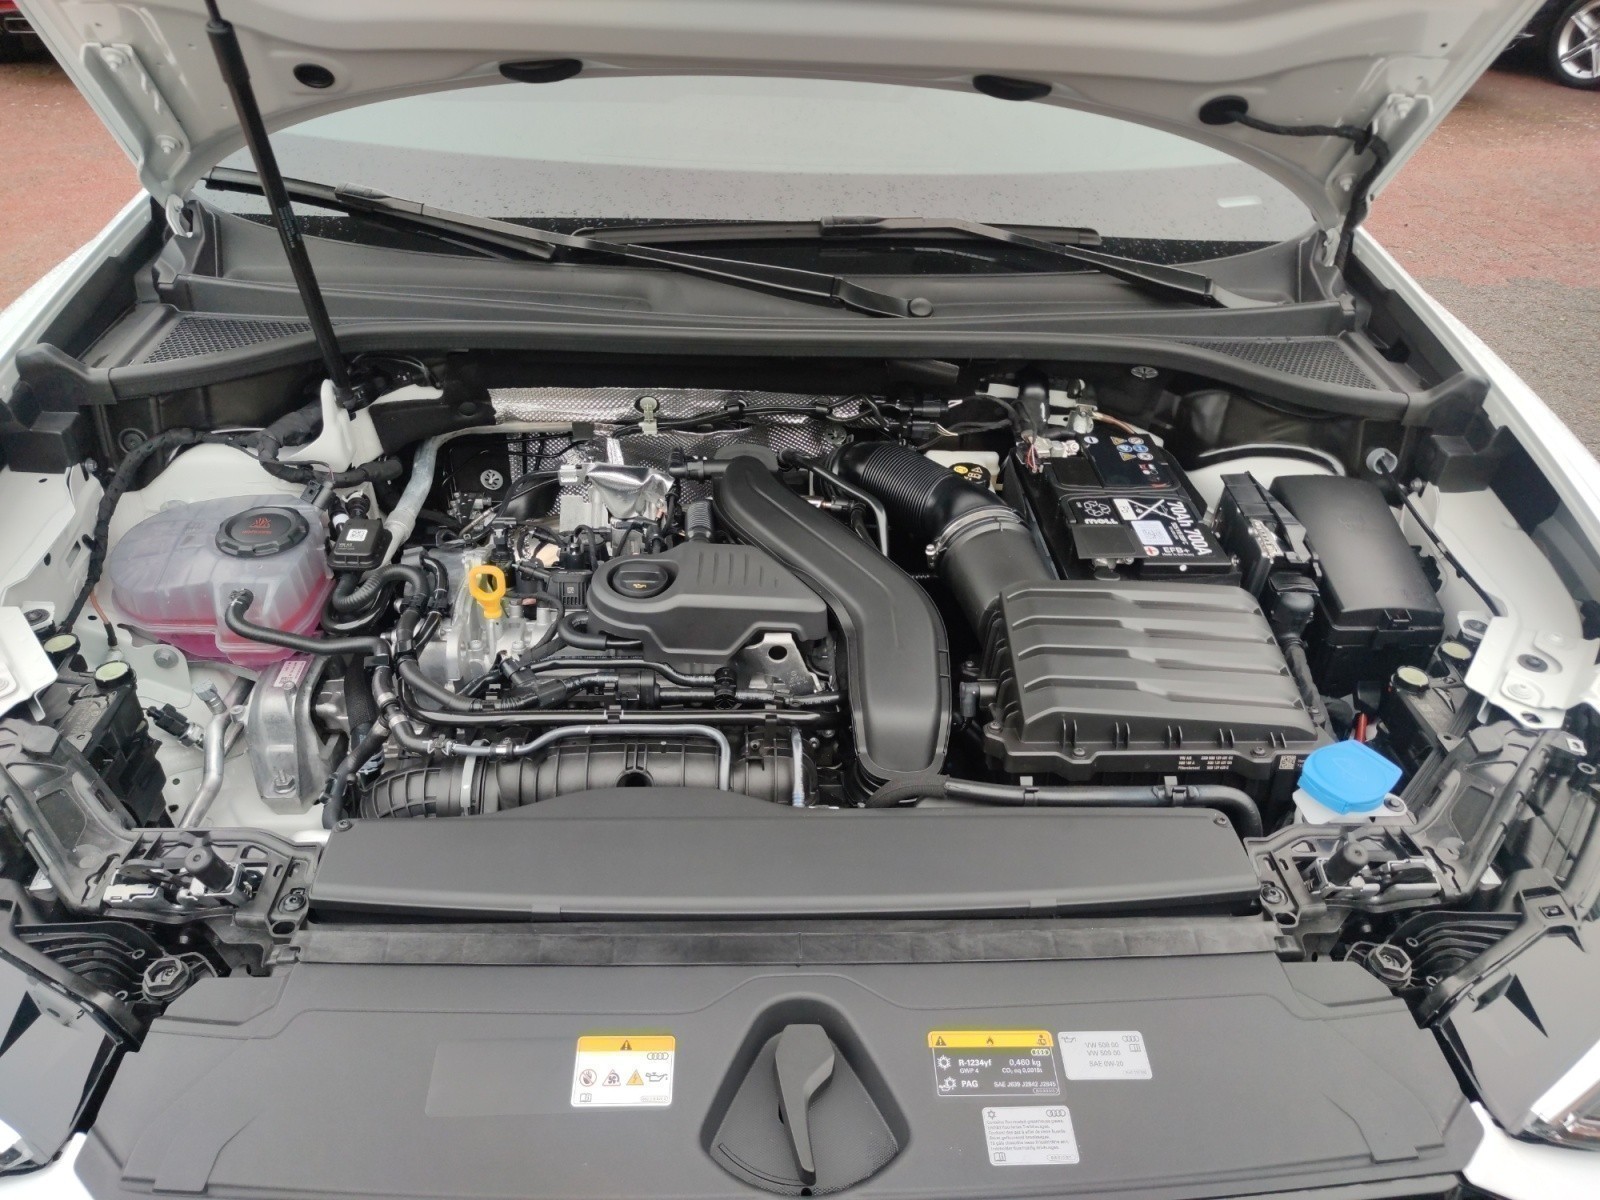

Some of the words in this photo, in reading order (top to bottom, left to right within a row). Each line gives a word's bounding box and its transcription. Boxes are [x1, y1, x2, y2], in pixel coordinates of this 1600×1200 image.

[1166, 501, 1194, 527] 70Ah
[1184, 528, 1213, 556] 700A
[958, 1058, 992, 1068] R-1234yf
[1008, 1058, 1031, 1067] 0,460
[1032, 1058, 1042, 1068] kg
[961, 1080, 979, 1088] PAG
